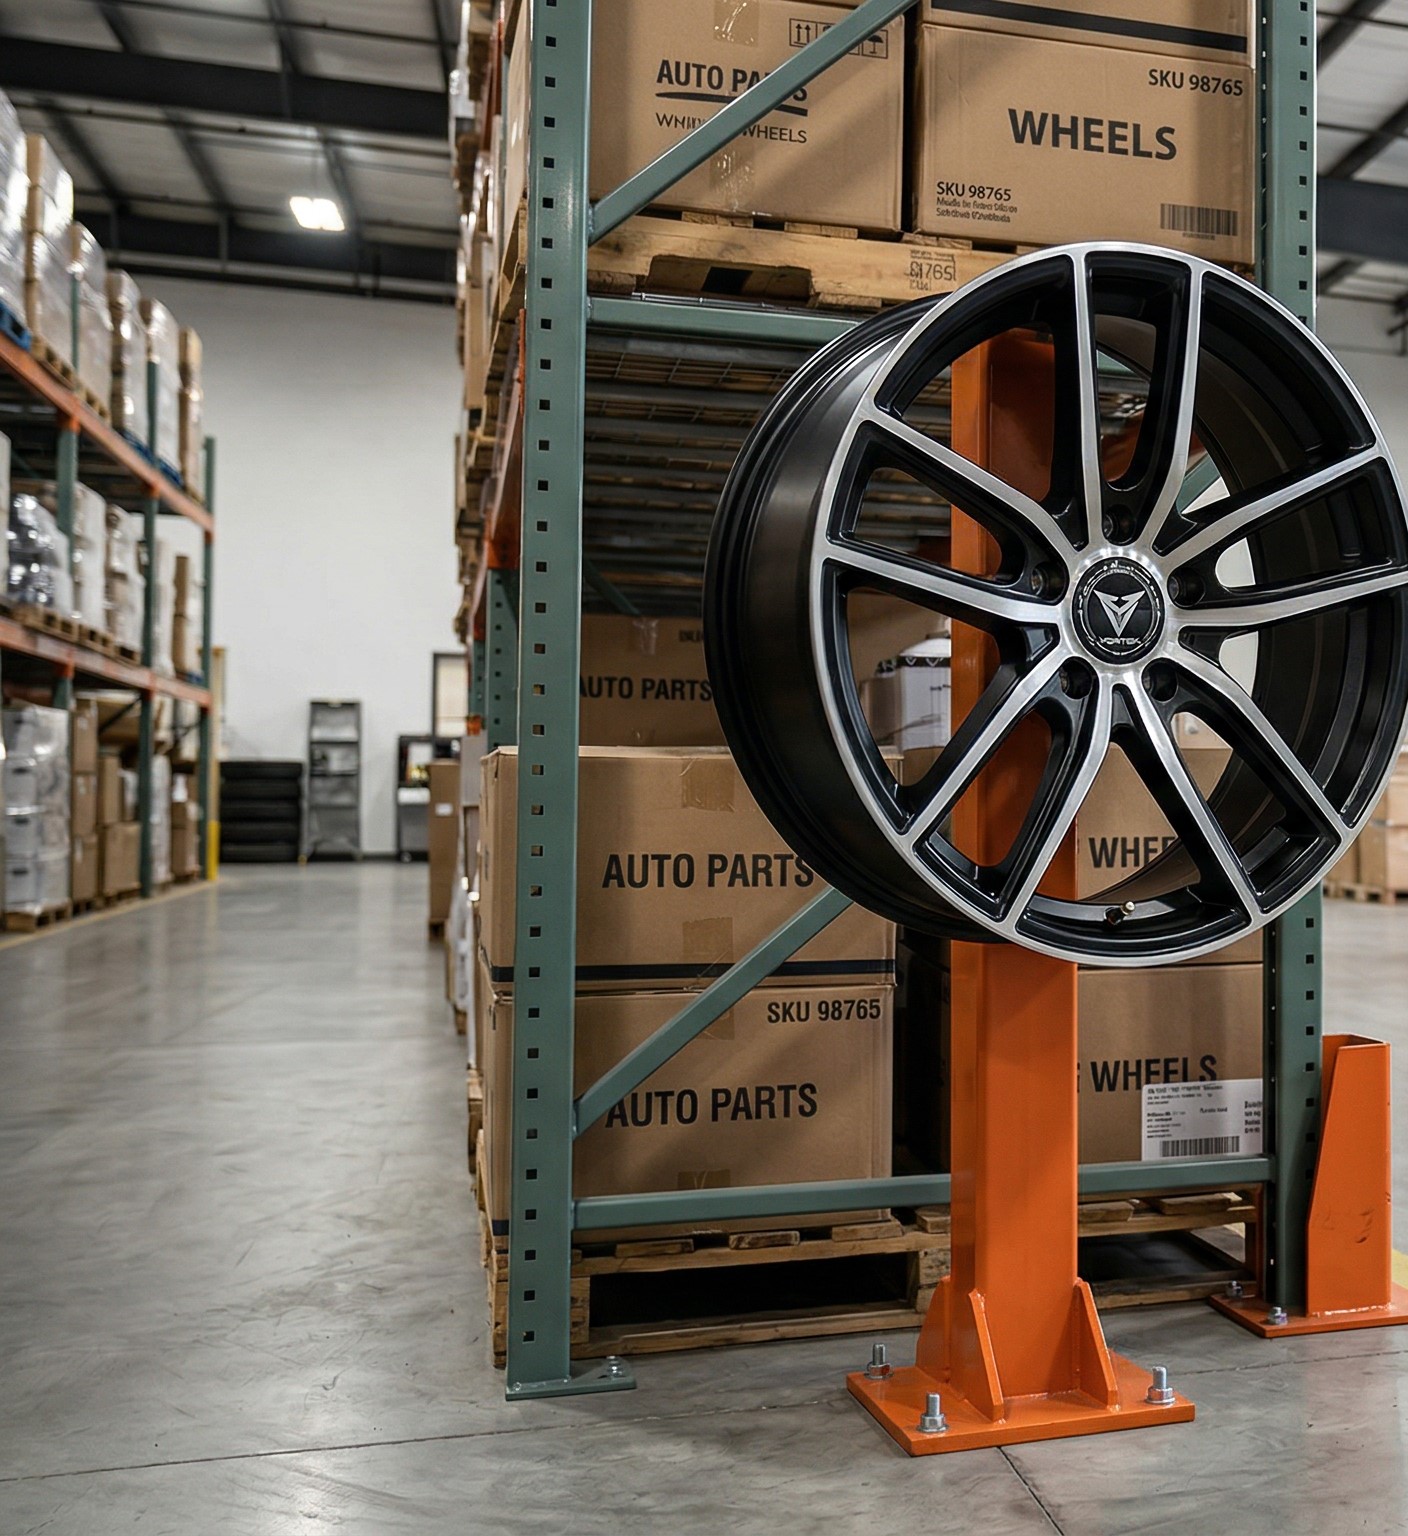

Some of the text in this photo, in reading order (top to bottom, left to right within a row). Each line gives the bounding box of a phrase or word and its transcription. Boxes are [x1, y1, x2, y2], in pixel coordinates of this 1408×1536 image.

[656, 59, 724, 91] AUTO
[1148, 68, 1243, 97] SKU 98765
[1008, 108, 1177, 161] WHEELS
[936, 181, 1012, 202] SKU 98765
[641, 678, 712, 702] PARTS
[602, 853, 814, 888] AUTO PARTS
[767, 999, 881, 1024] SKU 98765
[605, 1083, 818, 1129] AUTO PARTS
